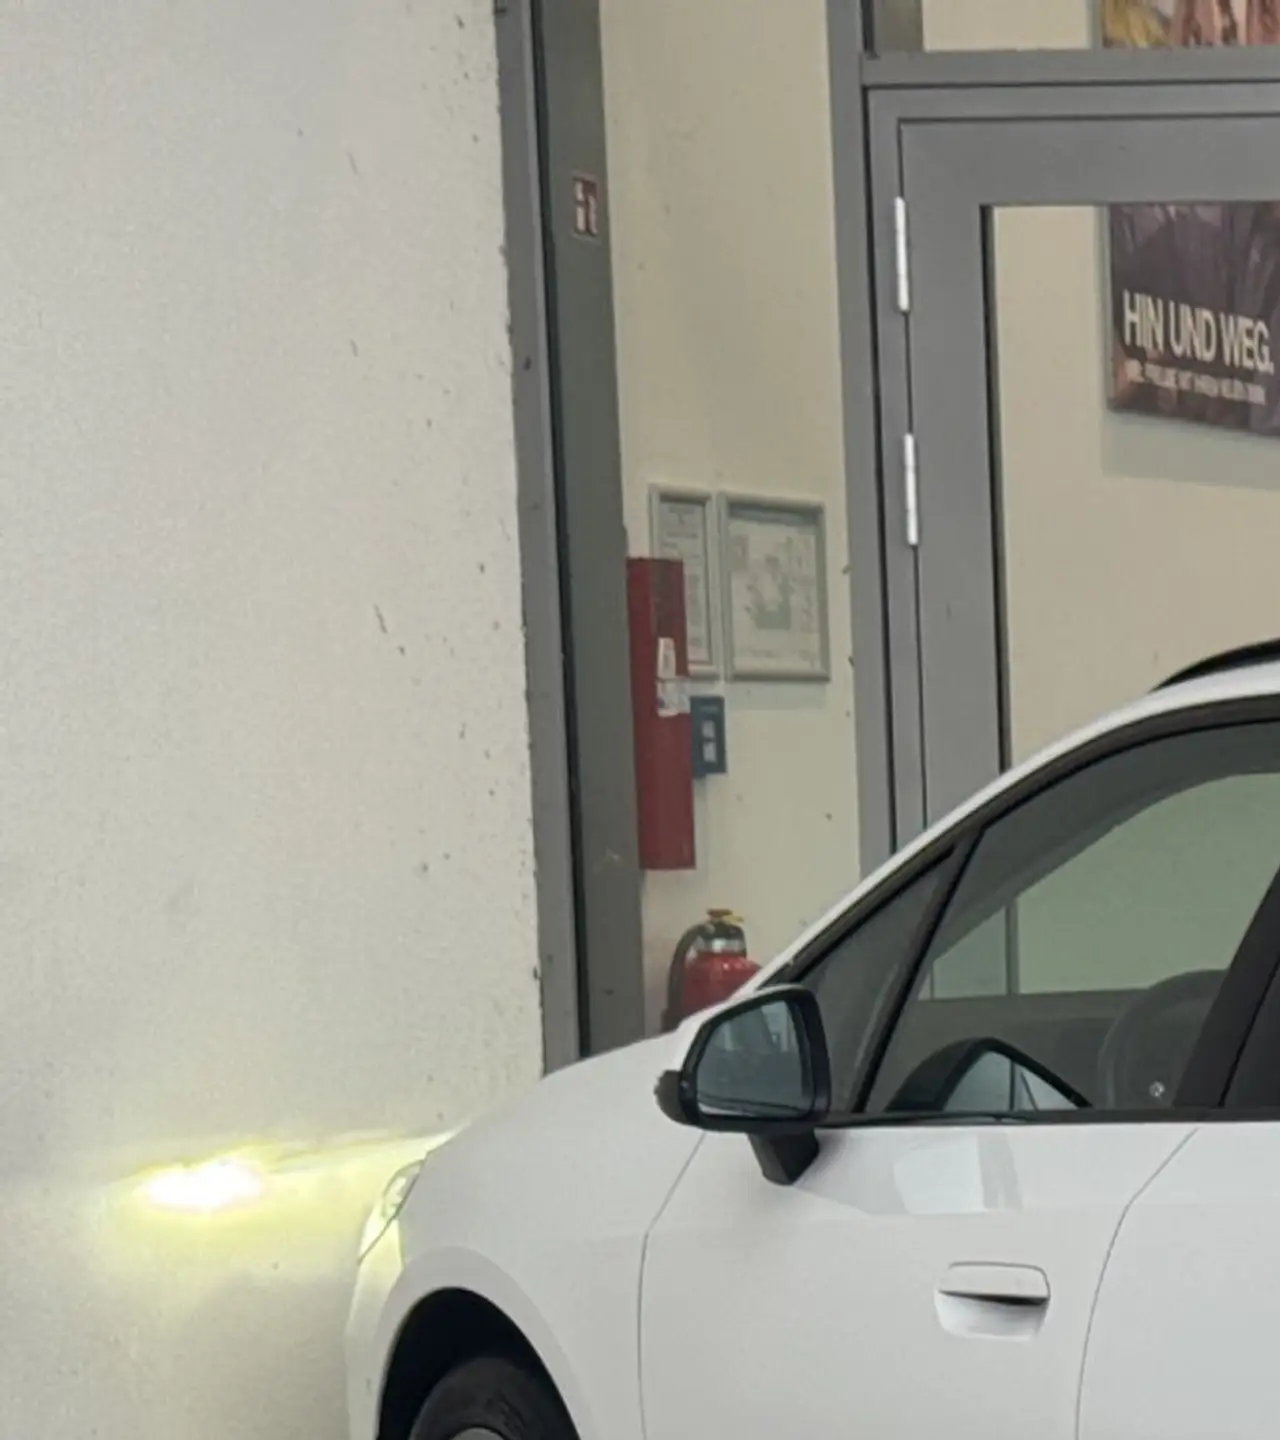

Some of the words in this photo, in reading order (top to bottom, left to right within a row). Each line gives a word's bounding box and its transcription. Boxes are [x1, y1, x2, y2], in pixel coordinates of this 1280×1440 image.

[1123, 289, 1164, 353] HIN
[1169, 300, 1218, 361] UND
[1220, 312, 1275, 376] WEG.
